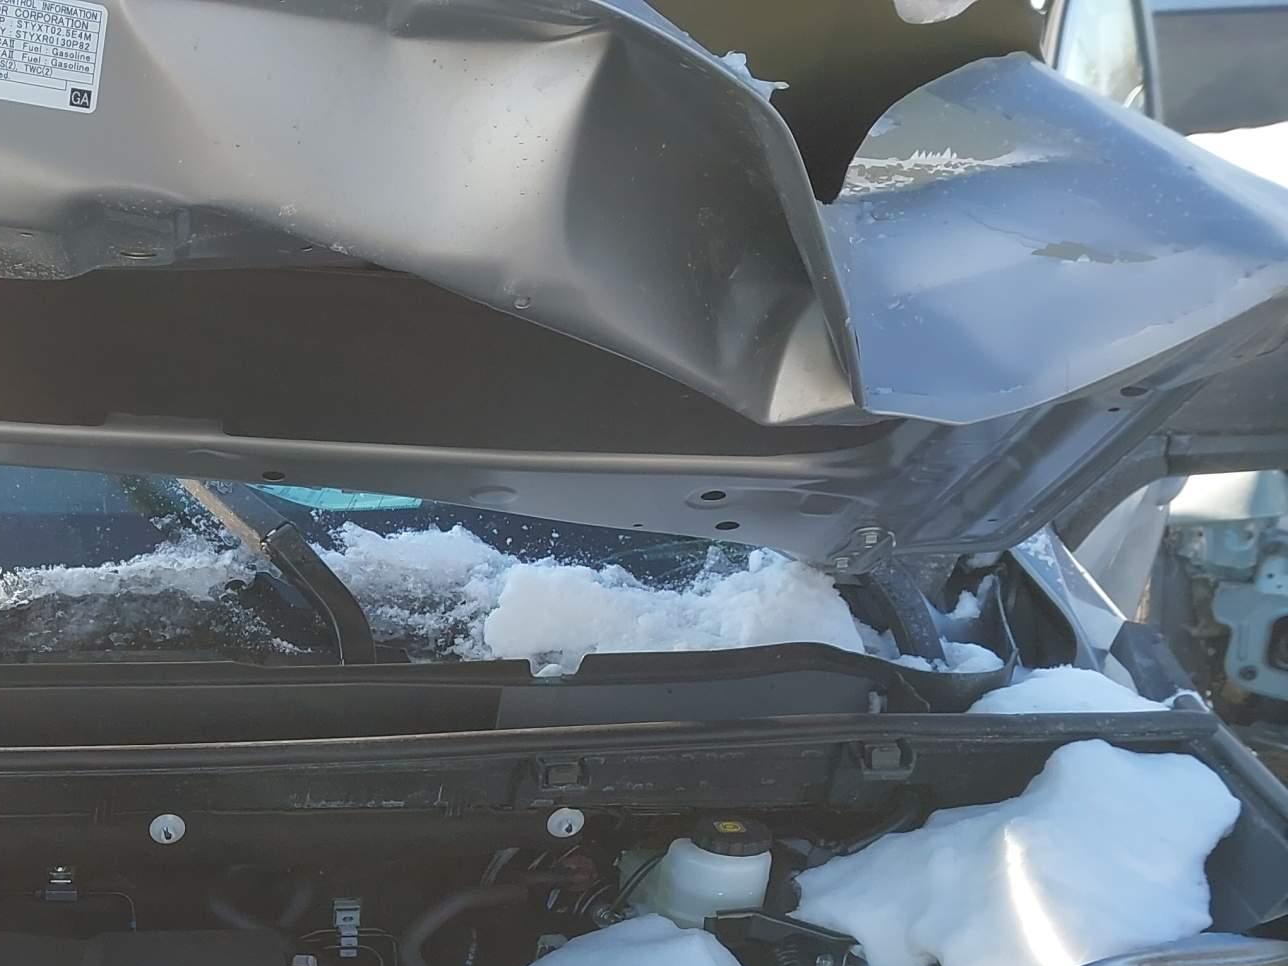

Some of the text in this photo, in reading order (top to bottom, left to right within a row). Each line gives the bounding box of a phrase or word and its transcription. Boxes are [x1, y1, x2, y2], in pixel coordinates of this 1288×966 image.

[14, 8, 89, 30] CORPORATION
[42, 3, 97, 20] INFORMATION
[22, 42, 42, 53] Fuel
[51, 48, 91, 62] Gasoline
[21, 52, 41, 64] Fuel
[50, 58, 90, 73] Gasoline
[24, 64, 53, 77] TWC(2)
[71, 91, 89, 106] GA
